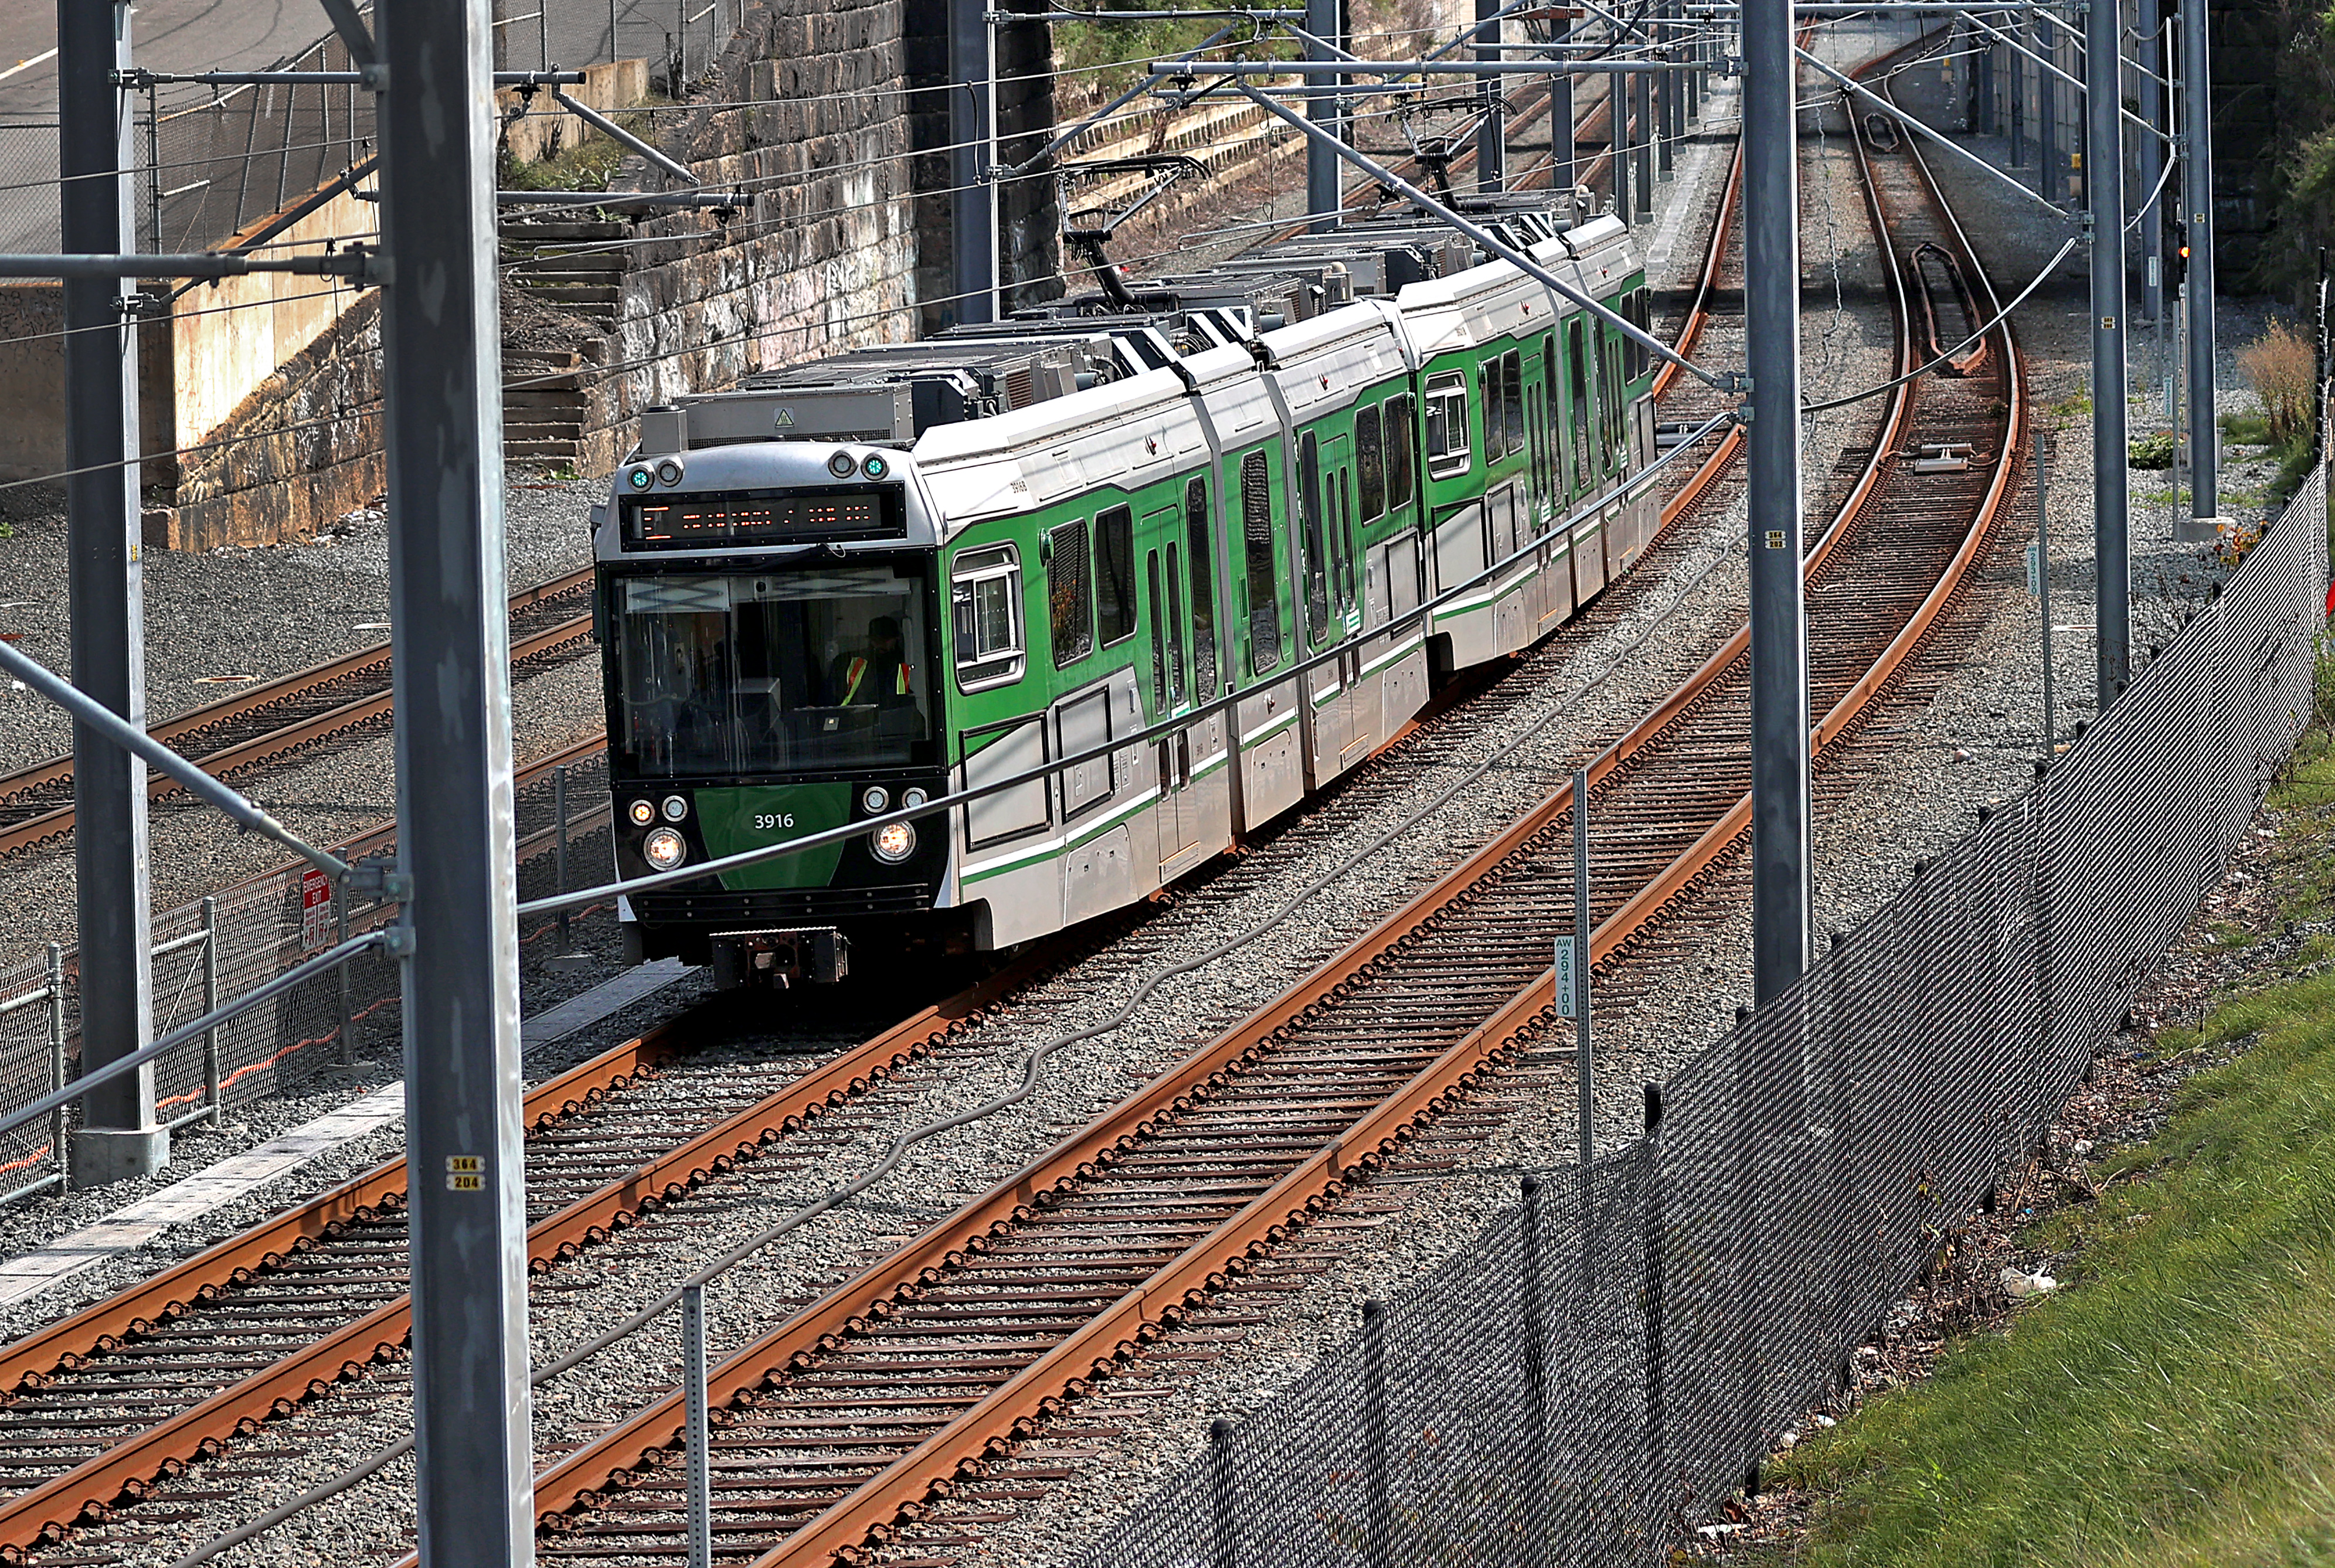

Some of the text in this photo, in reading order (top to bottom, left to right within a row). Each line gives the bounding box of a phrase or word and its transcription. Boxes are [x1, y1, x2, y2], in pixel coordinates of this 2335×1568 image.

[1010, 481, 1028, 494] 3916B
[754, 813, 794, 829] 3916
[303, 875, 328, 893] EMERGENCY
[312, 890, 322, 904] EXIT
[1556, 938, 1572, 947] AW
[1560, 948, 1570, 1016] 294+00
[453, 1158, 477, 1170] 364
[454, 1176, 478, 1188] 204
